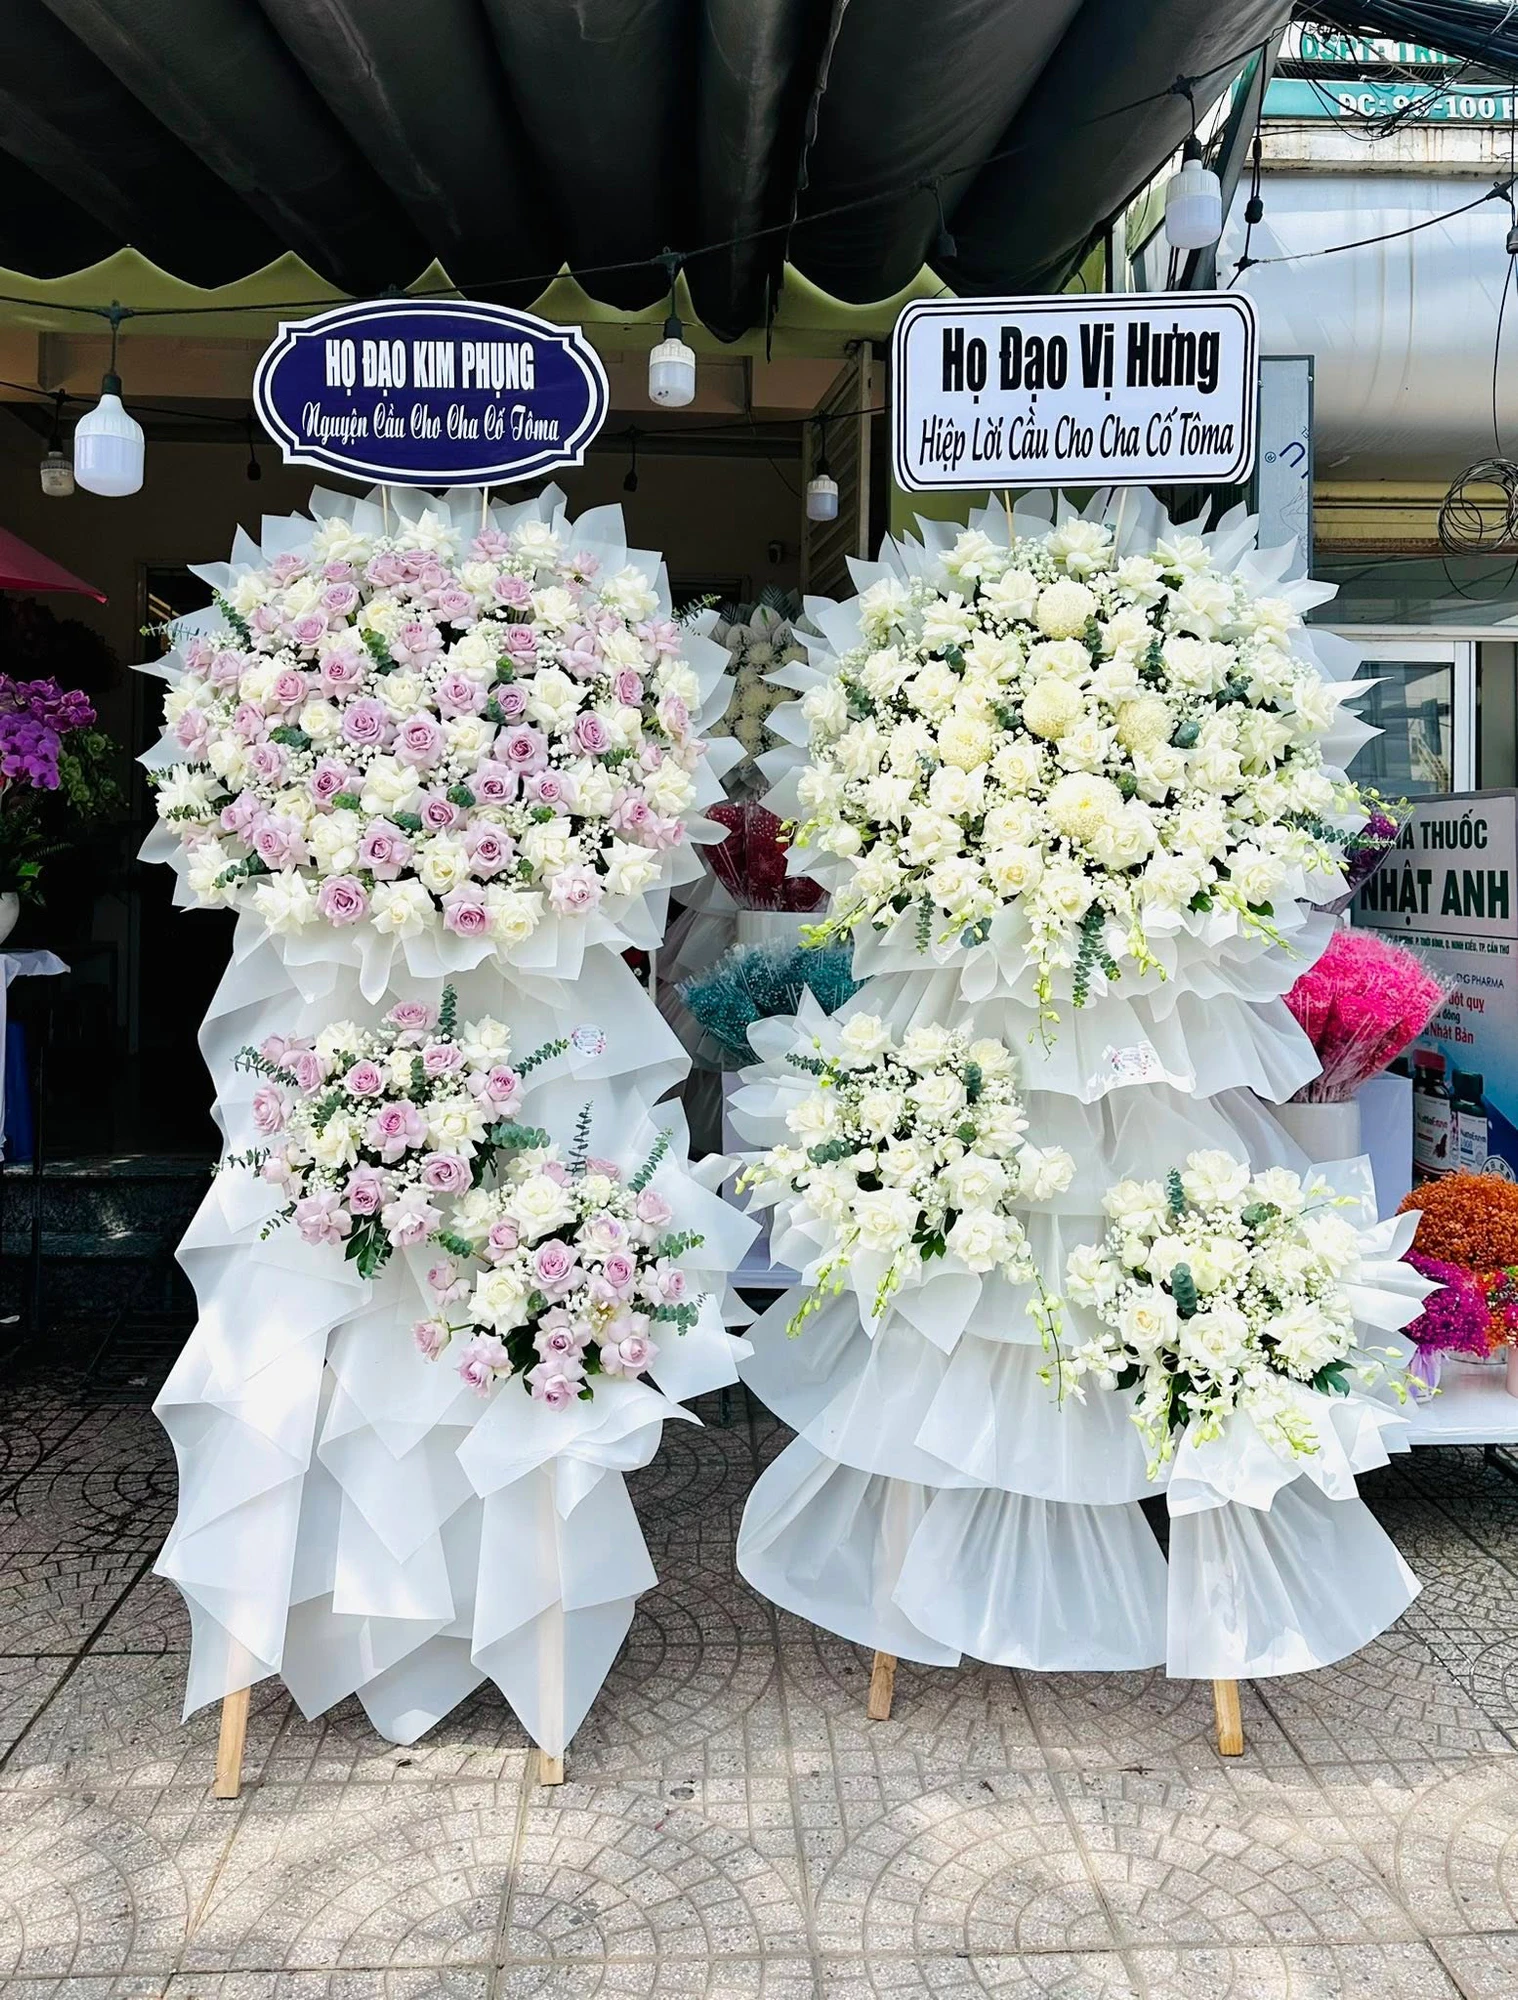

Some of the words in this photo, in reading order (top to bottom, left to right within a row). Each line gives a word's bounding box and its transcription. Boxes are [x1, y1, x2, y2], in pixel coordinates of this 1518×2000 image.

[325, 339, 356, 397] HỌ
[362, 340, 407, 397] ĐẠO
[413, 341, 455, 389] KIM
[462, 342, 535, 399] PHỤNG
[942, 327, 987, 404] Họ
[998, 325, 1068, 403] Đạo
[1079, 323, 1115, 401] Vị
[1126, 321, 1221, 395] Hưng
[302, 401, 369, 446] Nguyện
[373, 403, 406, 440] Cầu
[410, 402, 443, 441] Cho
[446, 404, 480, 441] Cha
[483, 405, 506, 442] Cố
[510, 404, 561, 442] Tôma
[918, 414, 967, 472] Hiệp
[971, 415, 1003, 461] Lời
[1008, 406, 1049, 461] Cầu
[1055, 414, 1094, 459] Cho
[1099, 413, 1140, 459] Cha
[1146, 405, 1178, 457] Cố
[1178, 411, 1235, 456] Tôma
[1420, 808, 1488, 850] THUỐC
[1361, 860, 1433, 926] NHẬT
[1441, 868, 1509, 920] ANH
[1471, 975, 1505, 989] PHARMA
